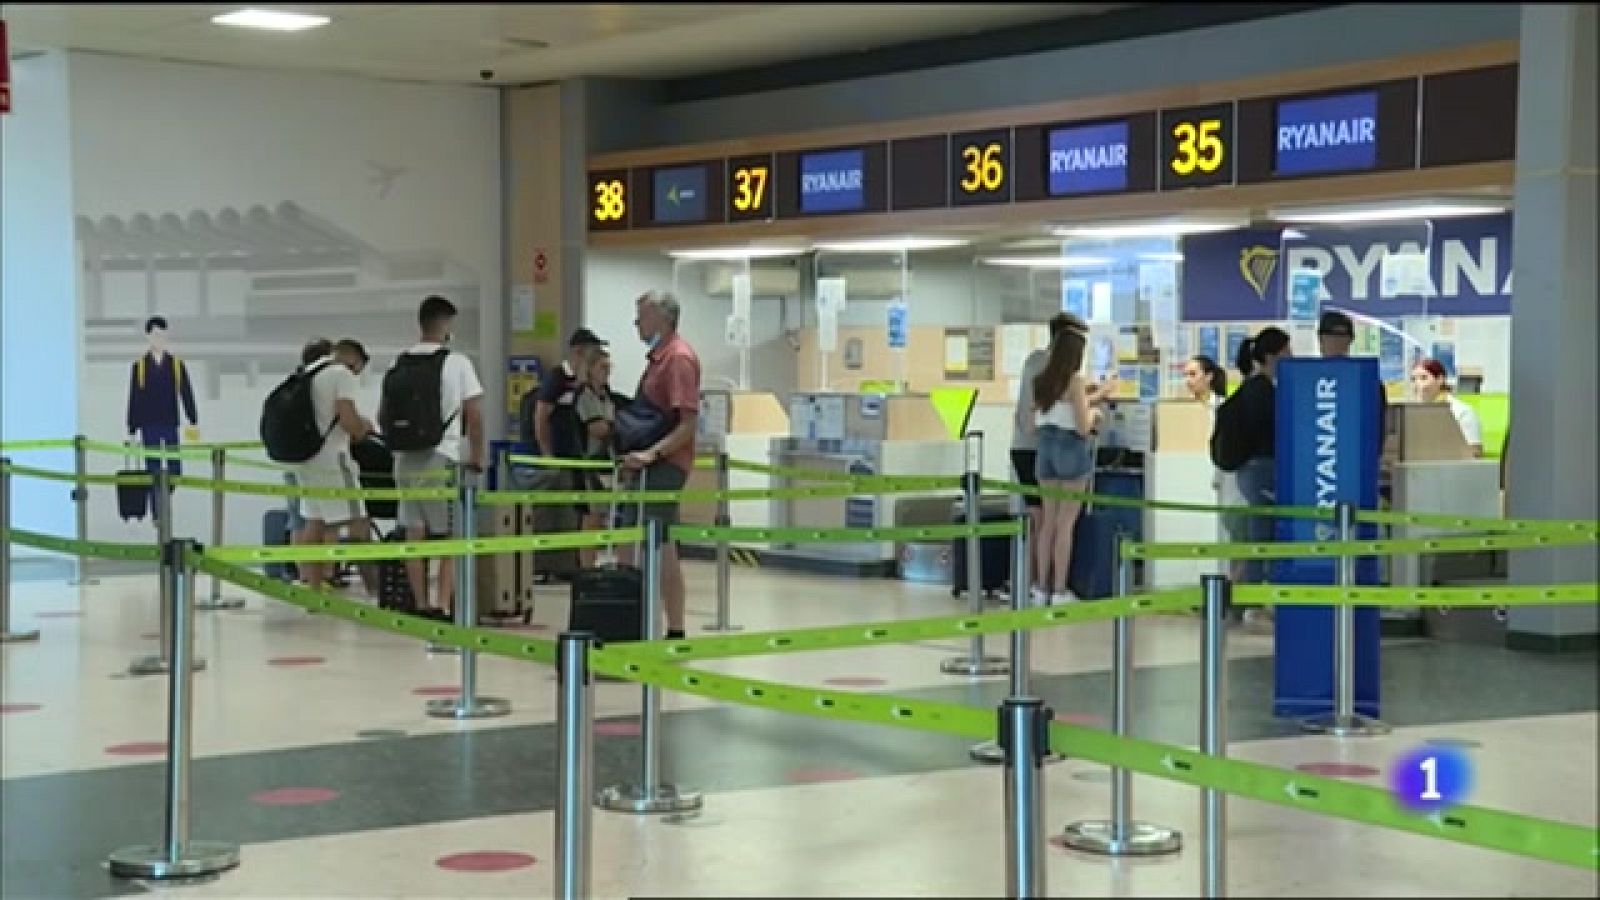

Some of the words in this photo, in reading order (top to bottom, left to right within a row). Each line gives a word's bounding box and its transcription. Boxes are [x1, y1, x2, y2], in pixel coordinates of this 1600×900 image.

[1171, 119, 1224, 176] 35
[1278, 115, 1375, 151] RYANAIR
[962, 144, 1003, 193] 36
[1050, 143, 1128, 174] RYANAIR
[594, 181, 626, 221] 38
[734, 167, 768, 210] 37
[802, 169, 862, 193] RYANAIR
[1287, 237, 1513, 301] RYN
